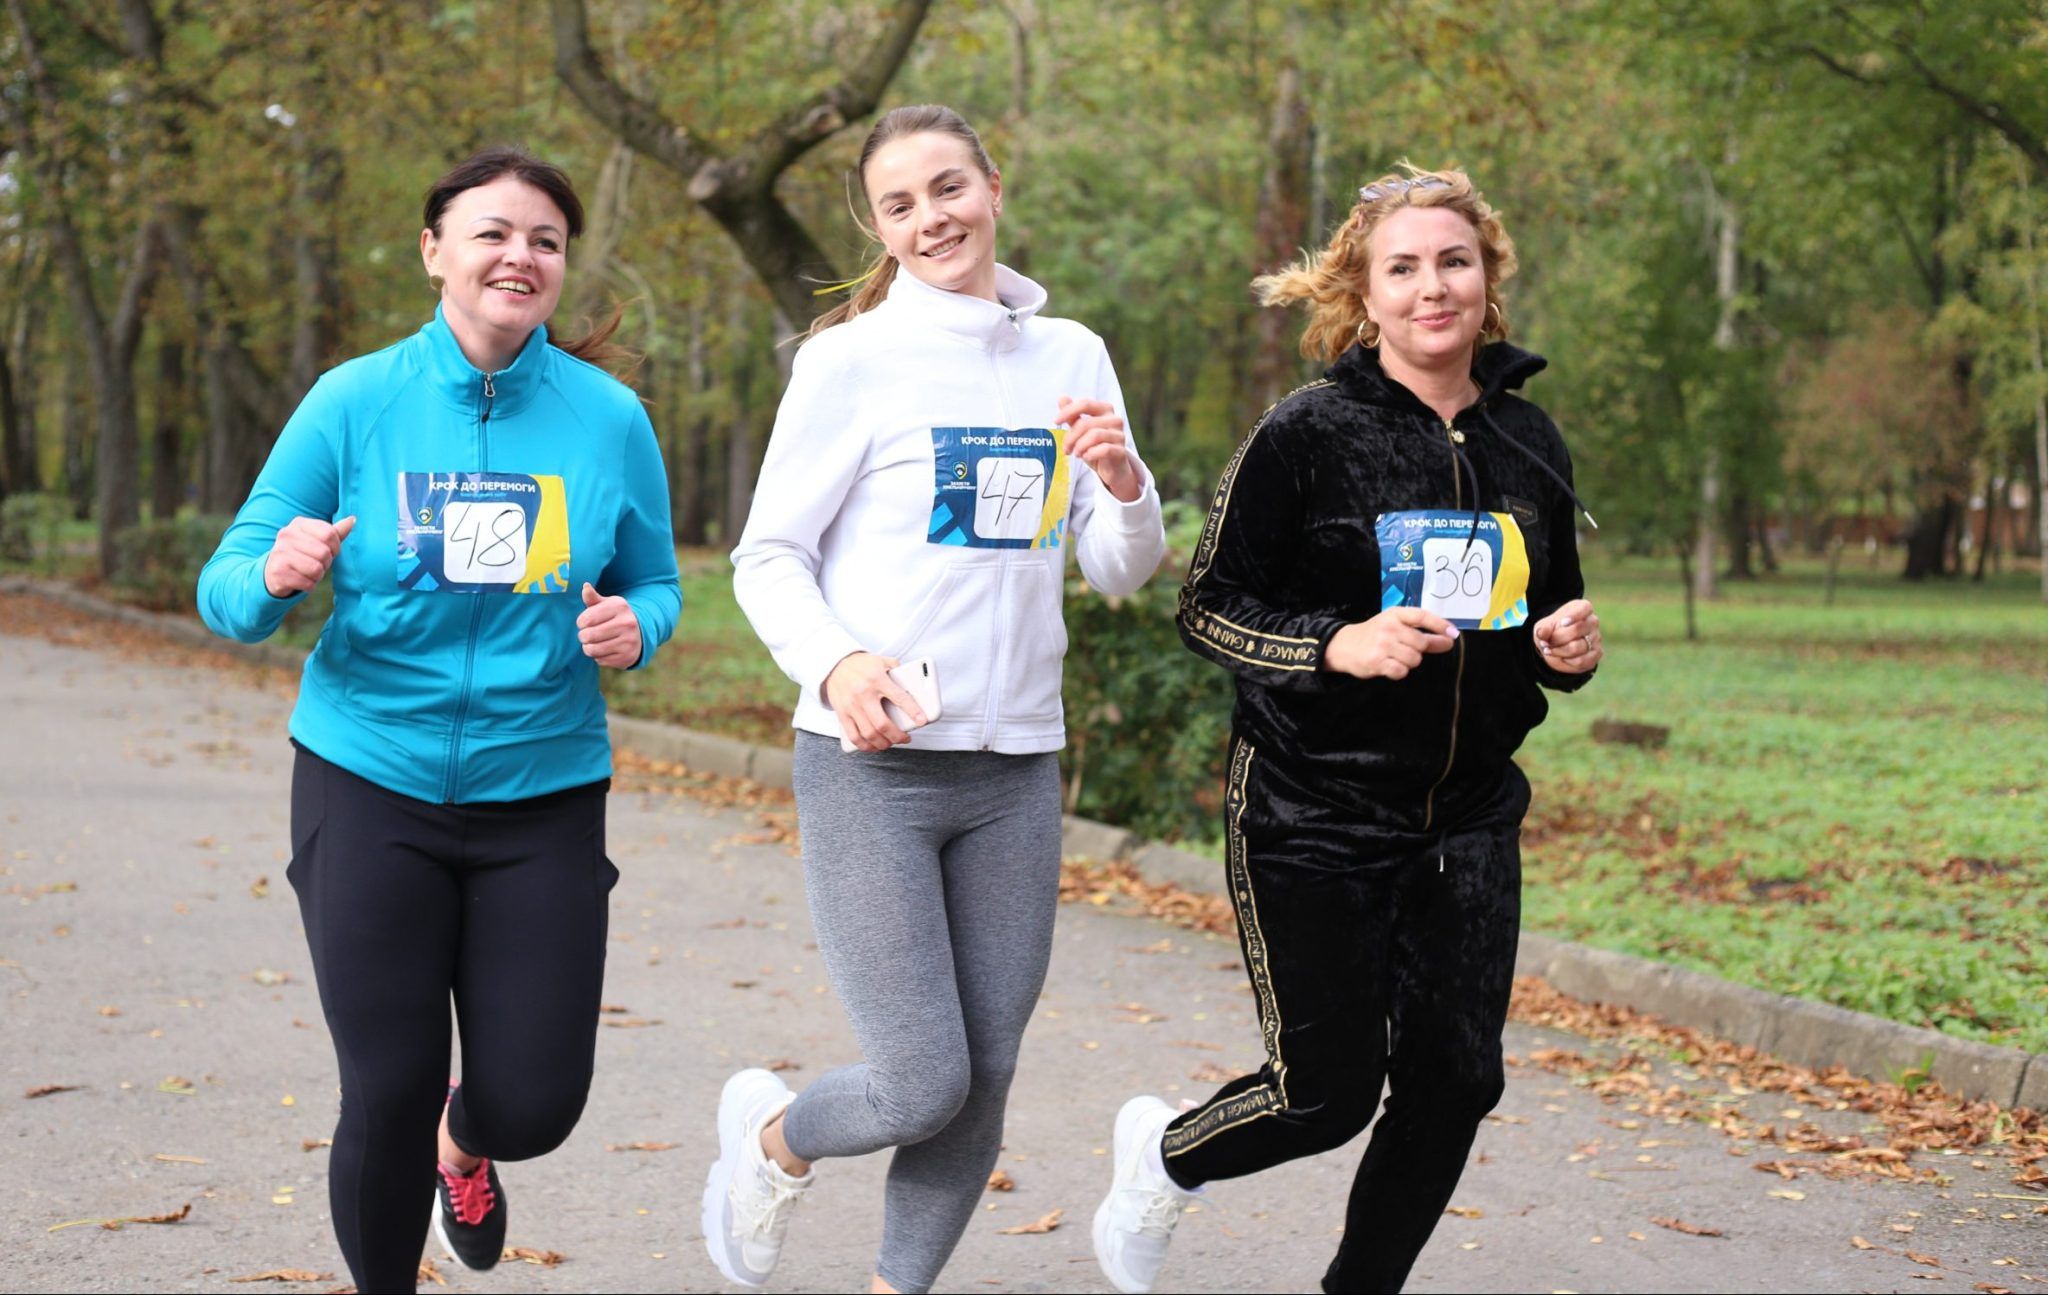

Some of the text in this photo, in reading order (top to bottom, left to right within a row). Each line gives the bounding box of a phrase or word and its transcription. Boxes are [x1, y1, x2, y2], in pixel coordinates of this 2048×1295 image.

[961, 436, 1053, 447] КРОК ДО ПЕРЕМОГИ
[430, 481, 536, 493] КРОК ДО ПЕРЕМОГИ
[981, 459, 1044, 527] 47
[450, 503, 525, 570] 48
[1200, 511, 1220, 563] GIANNI
[1403, 518, 1433, 529] КРОК
[1433, 518, 1448, 529] ДО
[1430, 551, 1484, 600] 36
